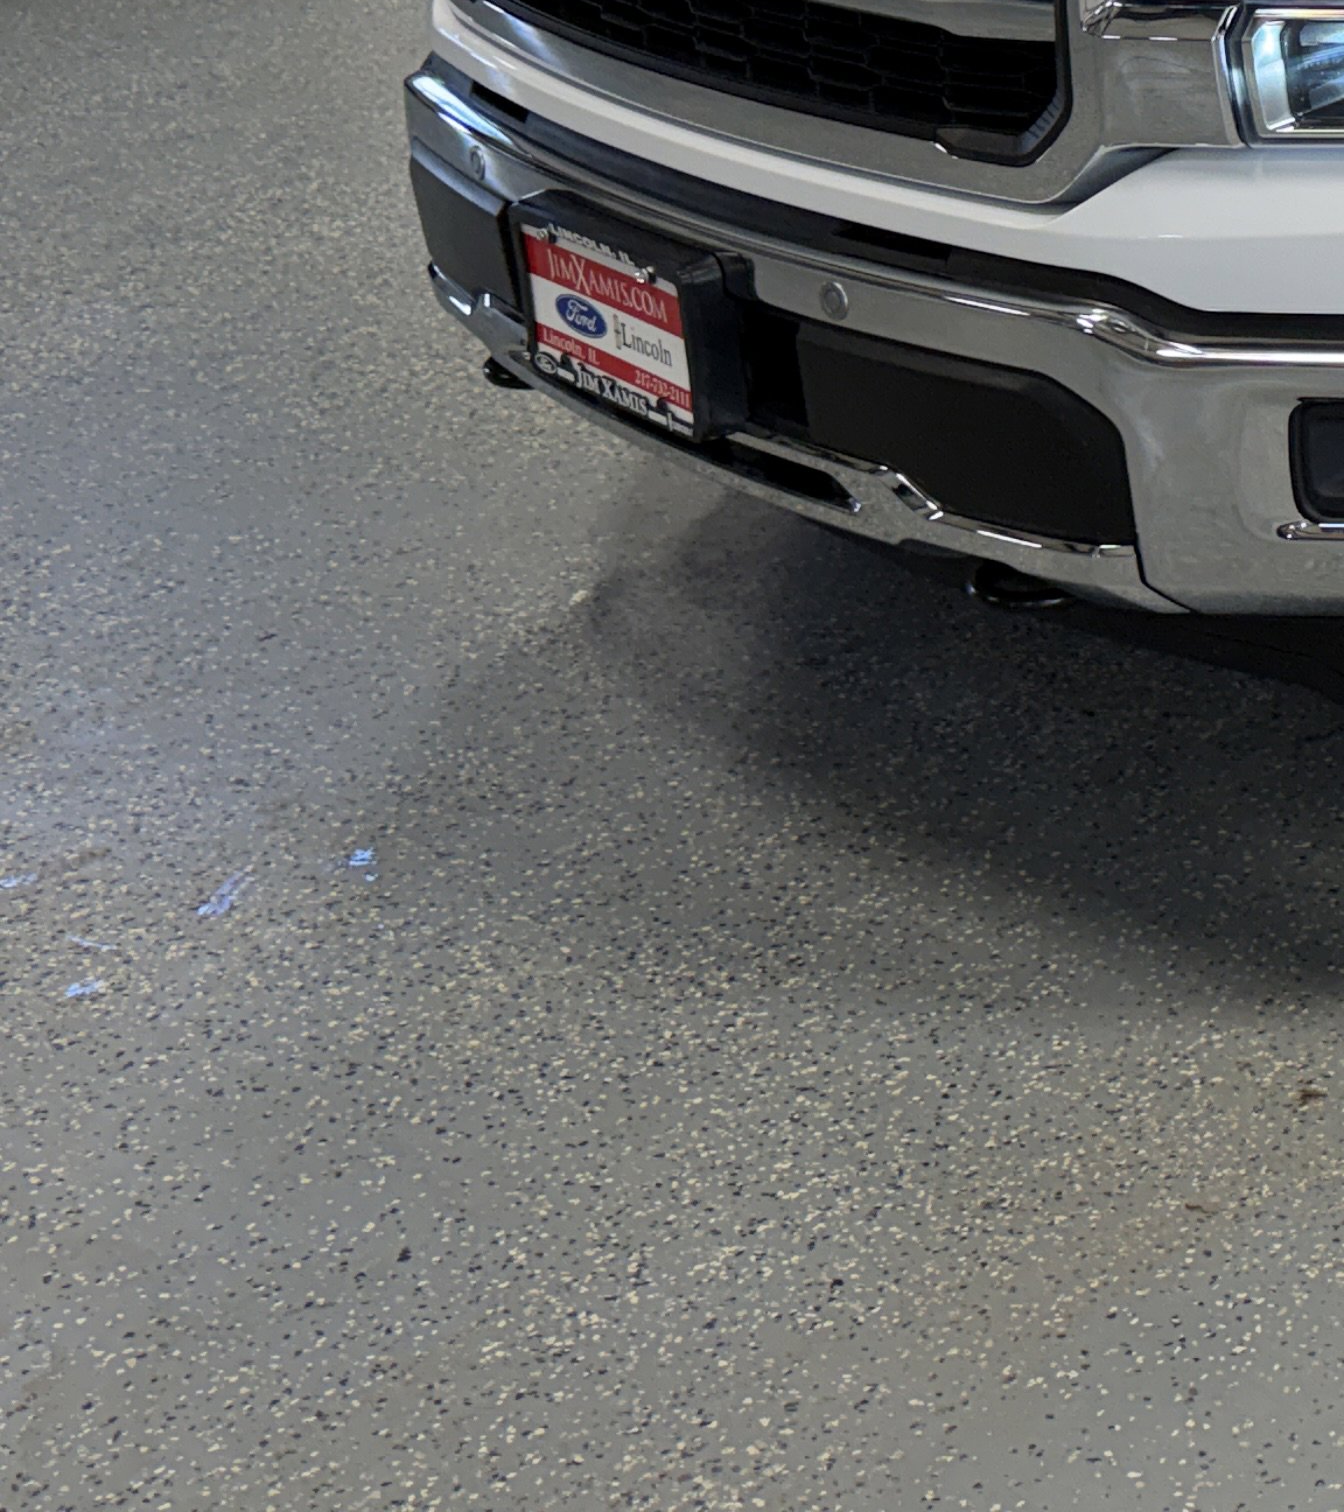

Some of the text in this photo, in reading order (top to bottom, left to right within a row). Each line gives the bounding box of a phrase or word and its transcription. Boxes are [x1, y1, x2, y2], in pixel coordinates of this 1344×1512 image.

[565, 298, 597, 333] Ford
[620, 322, 673, 367] Lincoln
[601, 378, 648, 416] XAMIS
